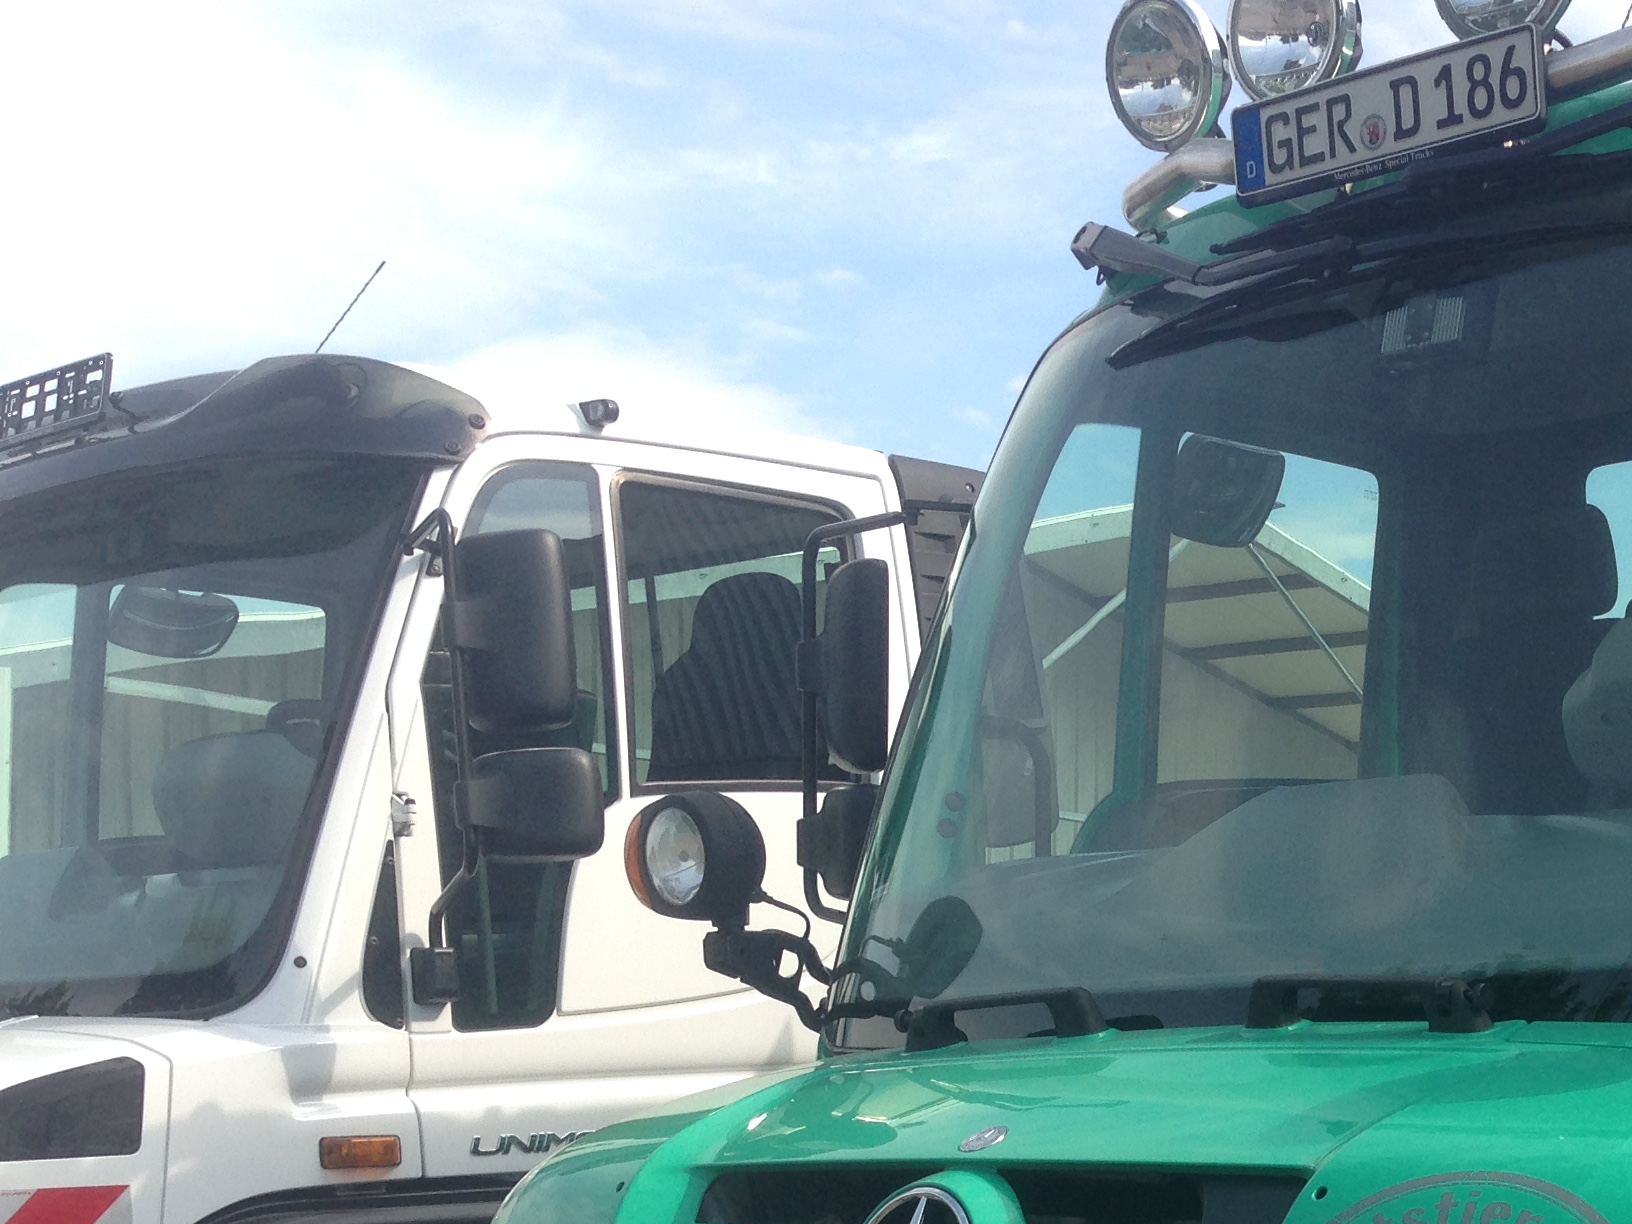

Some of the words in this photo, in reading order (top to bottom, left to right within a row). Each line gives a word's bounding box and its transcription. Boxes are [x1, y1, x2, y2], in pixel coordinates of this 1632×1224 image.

[1264, 92, 1358, 176] GER
[1389, 74, 1422, 143] D
[1433, 44, 1528, 131] 186
[1246, 160, 1257, 179] D
[1334, 162, 1383, 181] Mercedes-Benz
[1384, 154, 1409, 170] Special
[469, 1129, 596, 1157] UNIM
